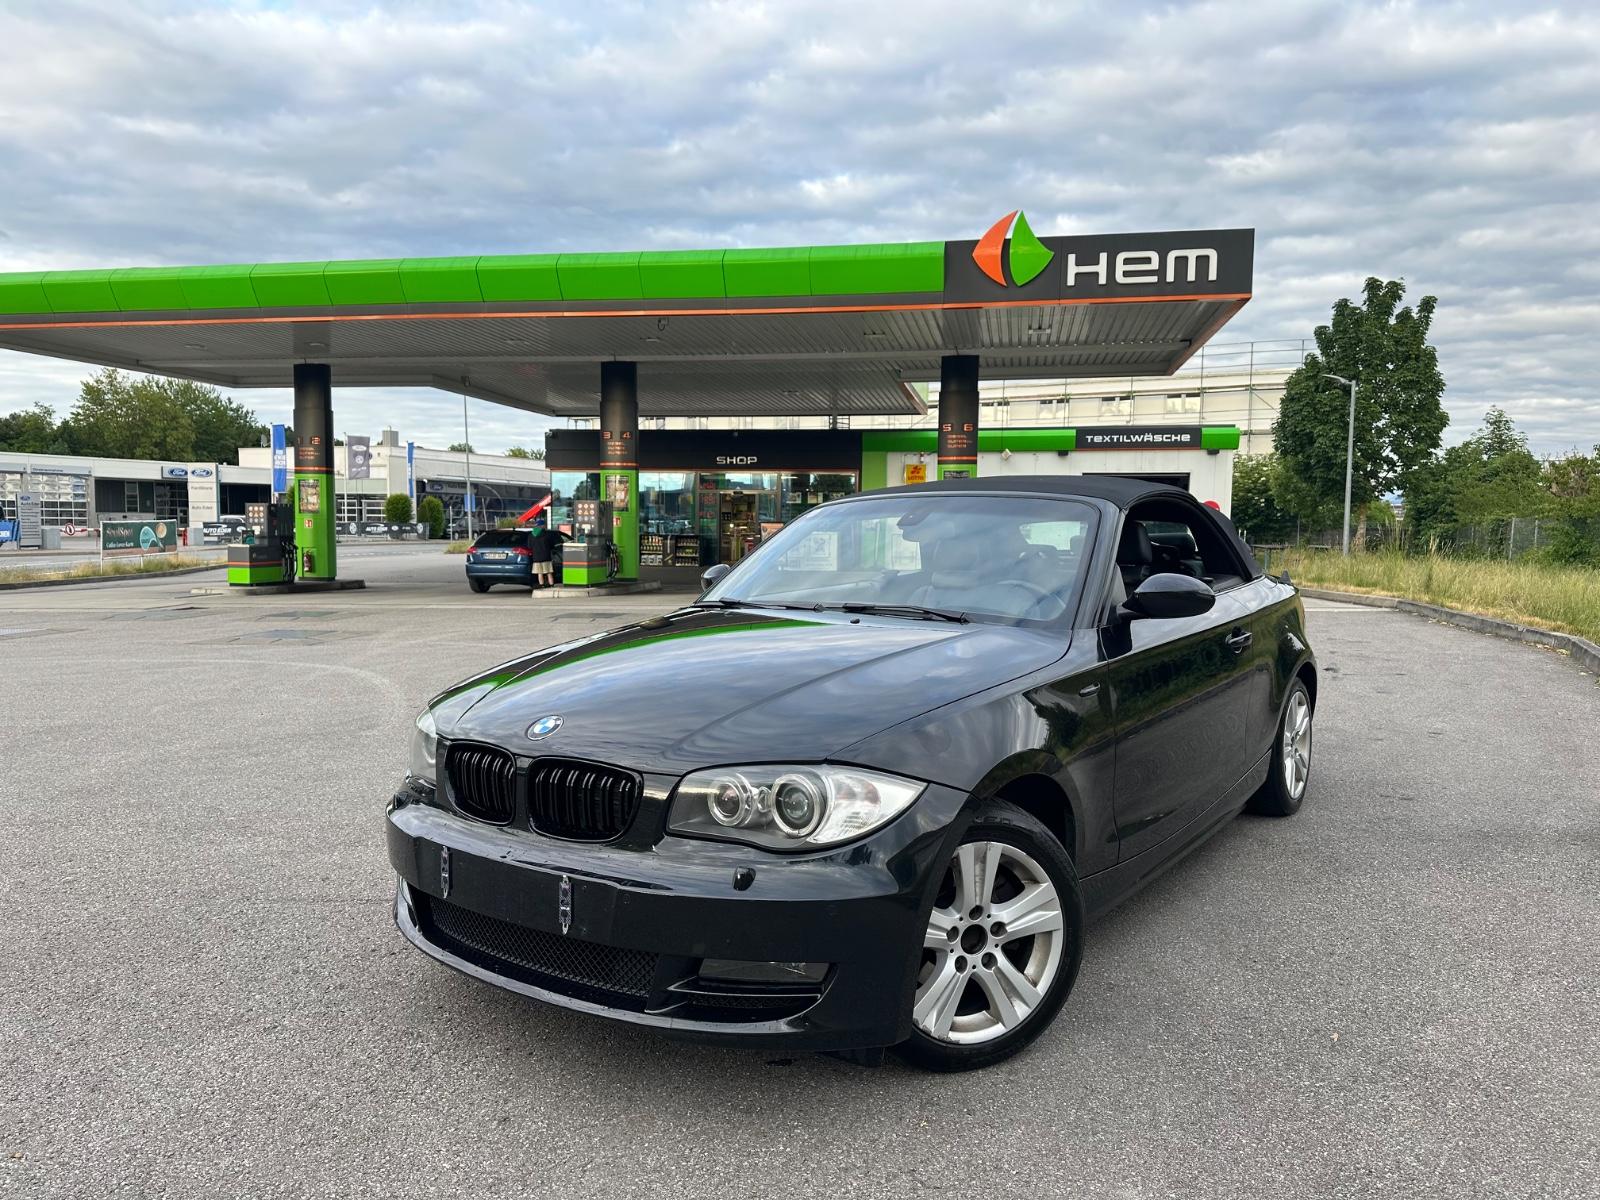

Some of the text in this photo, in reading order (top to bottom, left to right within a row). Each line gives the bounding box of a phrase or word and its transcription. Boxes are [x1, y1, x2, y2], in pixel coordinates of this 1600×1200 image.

[963, 423, 973, 432] 6
[602, 431, 611, 439] 3
[622, 431, 632, 439] 4
[716, 456, 758, 465] SHOP
